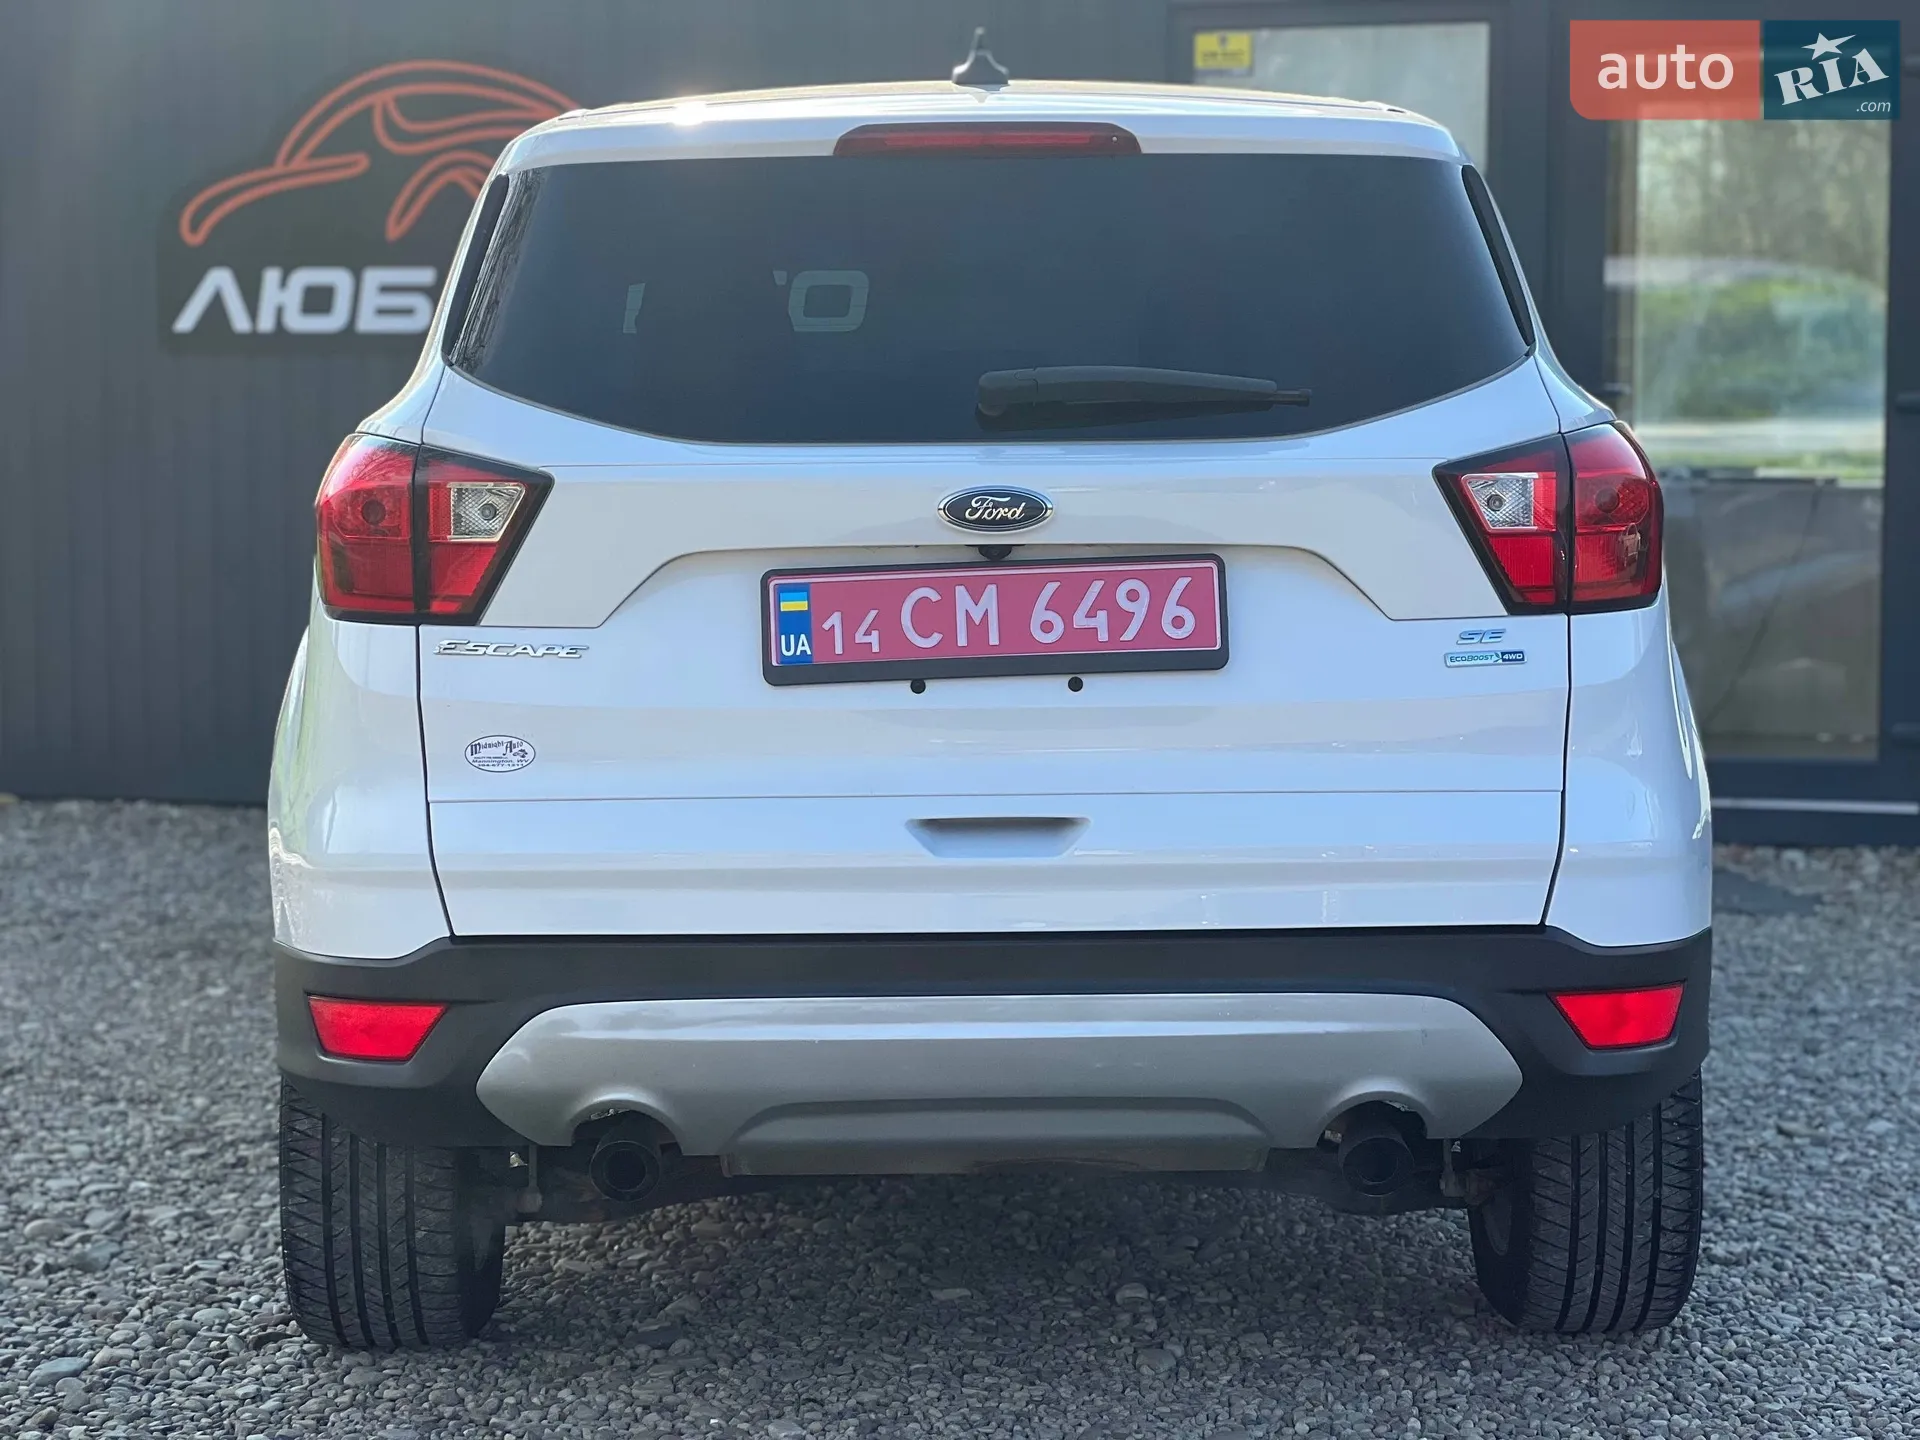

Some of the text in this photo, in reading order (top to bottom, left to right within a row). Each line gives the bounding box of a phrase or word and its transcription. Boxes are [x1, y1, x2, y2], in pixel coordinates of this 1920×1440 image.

[172, 266, 438, 334] ЛЮБ
[965, 495, 1027, 520] Ford
[821, 576, 1196, 655] 14 CM 6496
[780, 633, 812, 656] UA
[1456, 627, 1507, 645] SE
[433, 639, 590, 659] ESCAPE
[470, 740, 524, 756] Midnight Auto
